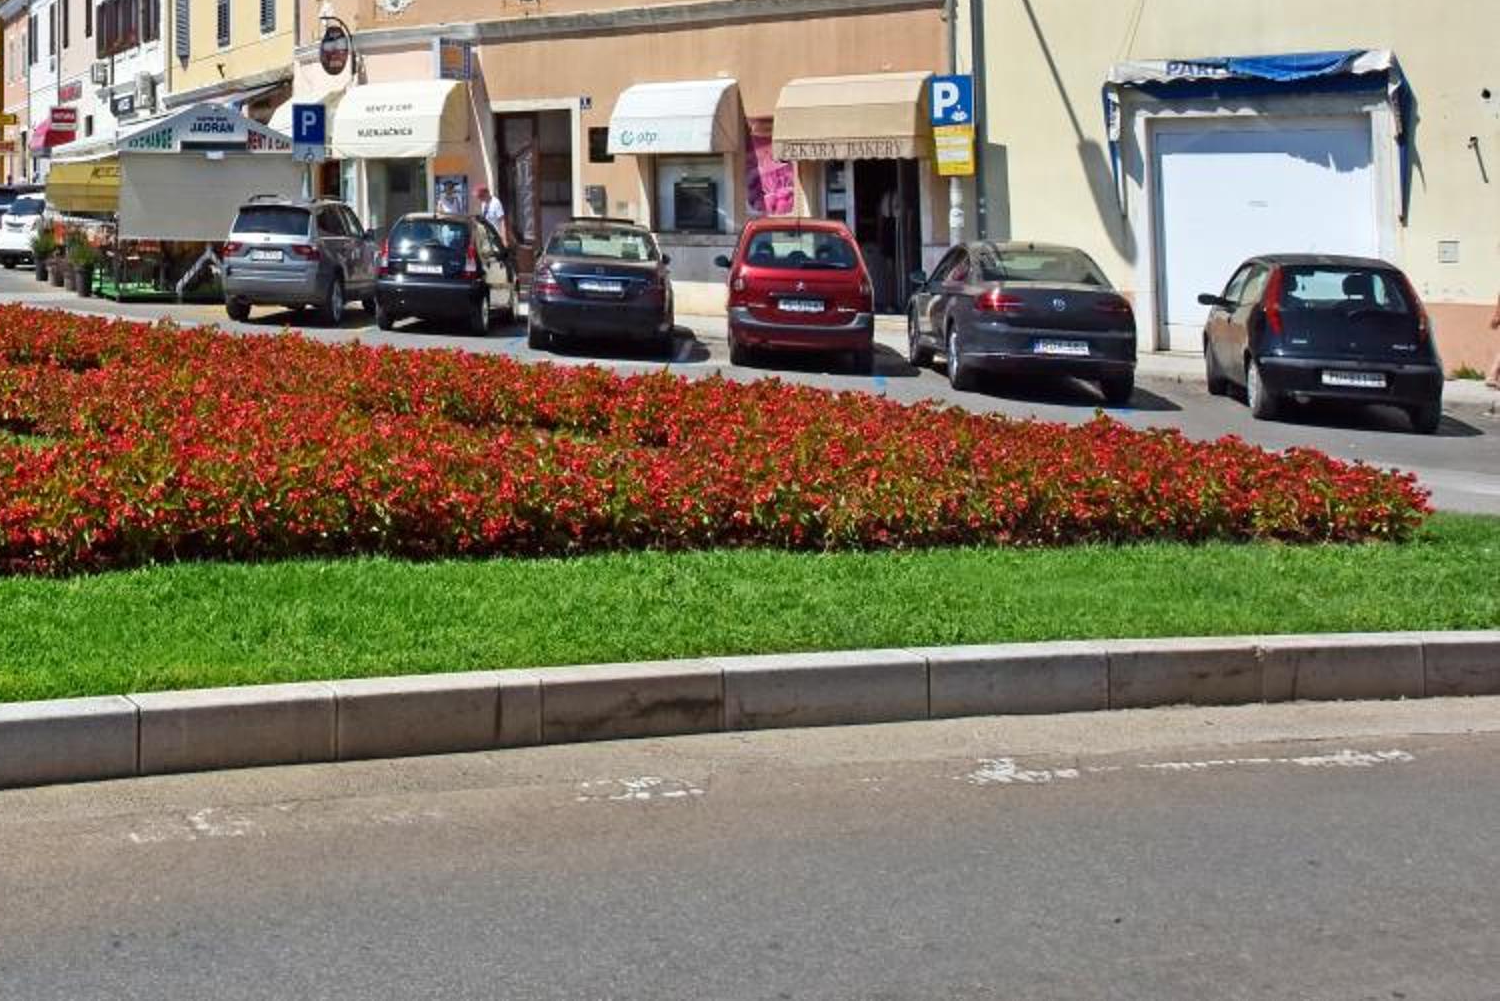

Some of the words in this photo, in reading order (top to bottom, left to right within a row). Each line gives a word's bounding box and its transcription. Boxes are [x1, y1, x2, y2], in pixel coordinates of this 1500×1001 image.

[932, 82, 959, 119] P
[190, 122, 235, 133] JADRAN
[301, 111, 316, 136] P
[782, 141, 837, 158] PEKARA
[847, 139, 903, 156] BAKERY
